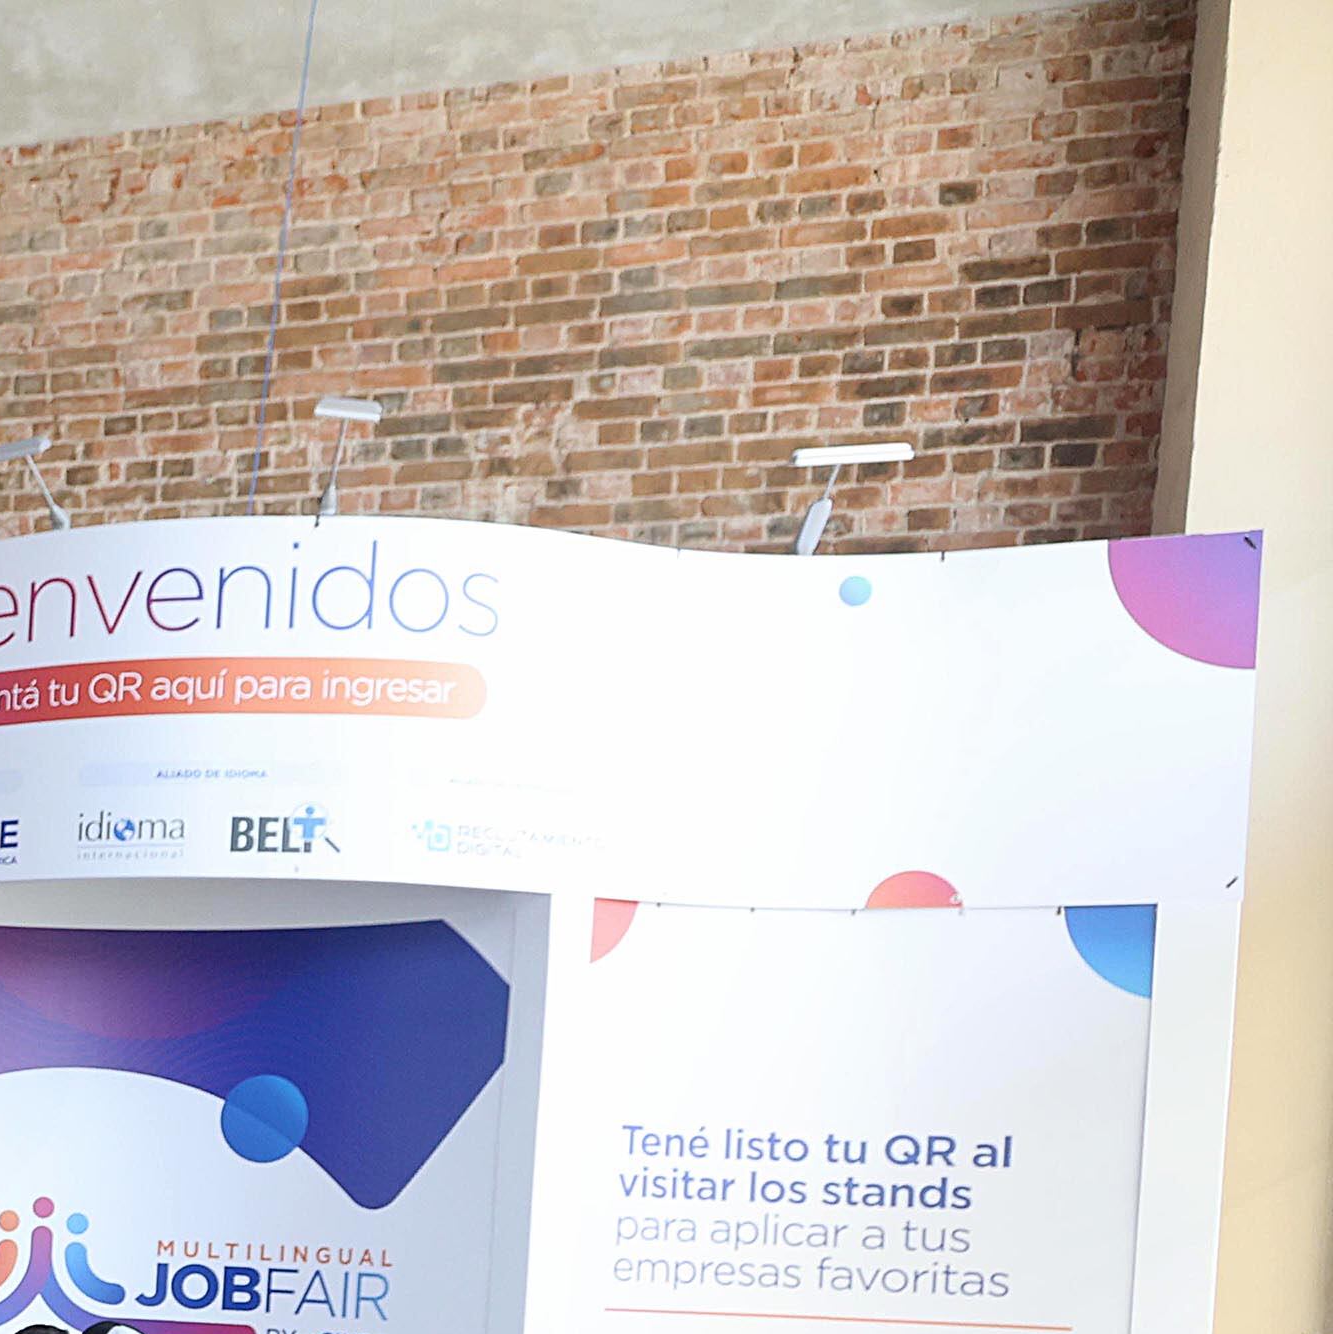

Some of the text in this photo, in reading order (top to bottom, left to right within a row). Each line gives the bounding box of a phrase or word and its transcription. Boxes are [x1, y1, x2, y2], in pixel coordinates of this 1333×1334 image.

[48, 679, 81, 708] tu
[88, 671, 143, 704] QR
[150, 668, 229, 705] aquí
[234, 674, 312, 705] para
[322, 669, 457, 707] ingresar
[156, 768, 268, 779] ALIADO DE IDIOMA
[77, 811, 185, 842] idioma
[622, 1125, 1014, 1169] Tené listo tu QR al
[619, 1166, 973, 1210] visitar los stands
[616, 1213, 971, 1253] para aplicar a tus
[156, 1240, 394, 1268] MULTILINGUAL
[134, 1262, 390, 1322] JOBFAIR
[612, 1257, 1011, 1299] empresas favoritas
